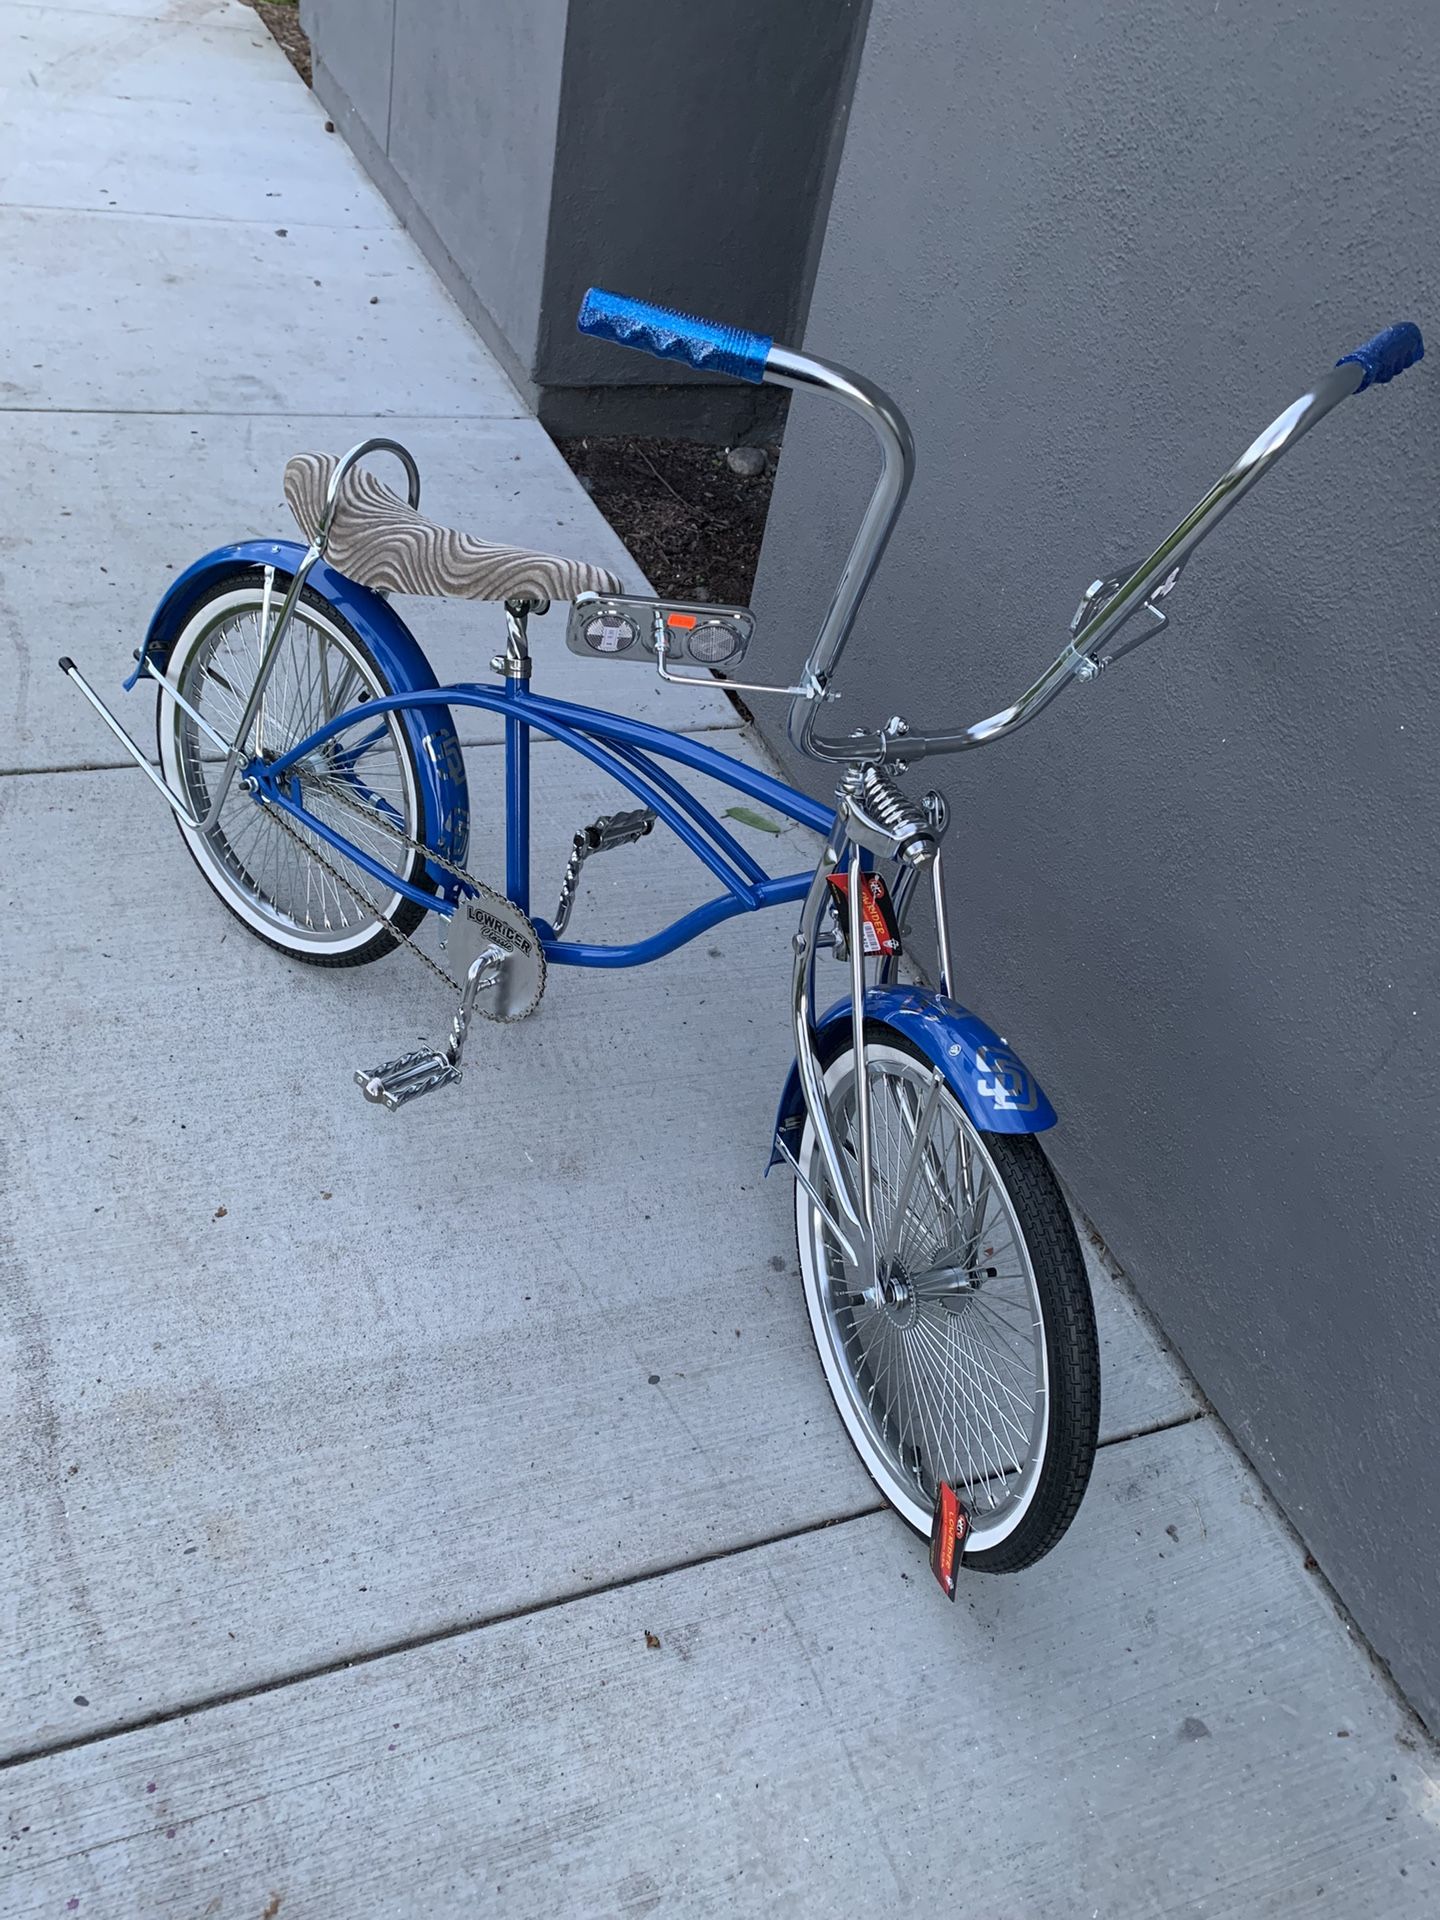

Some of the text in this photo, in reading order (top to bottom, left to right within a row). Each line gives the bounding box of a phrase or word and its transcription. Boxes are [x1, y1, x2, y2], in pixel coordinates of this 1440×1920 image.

[467, 905, 531, 955] LOWRIDER
[862, 891, 885, 936] WRIDER
[481, 926, 513, 951] Classic
